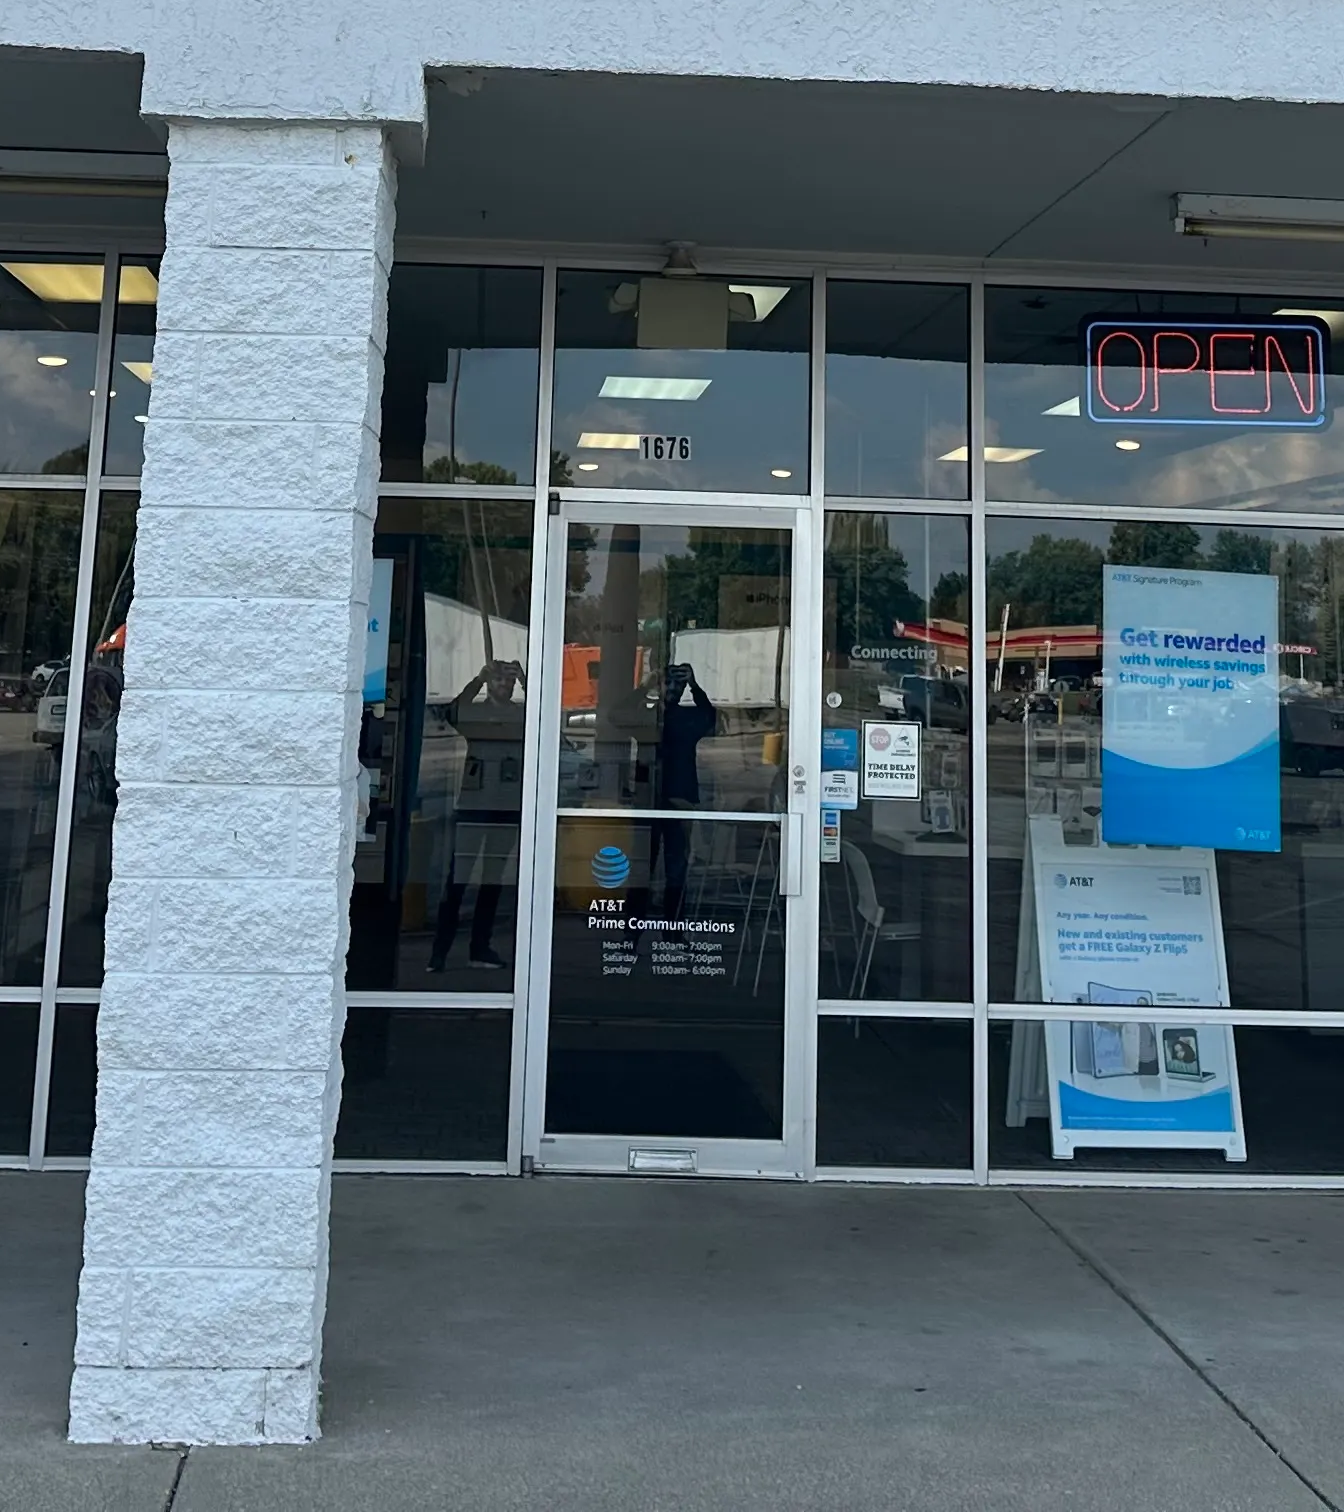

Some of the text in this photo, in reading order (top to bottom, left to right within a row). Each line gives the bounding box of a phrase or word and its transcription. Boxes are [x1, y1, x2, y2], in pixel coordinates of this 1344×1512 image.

[1097, 331, 1314, 414] OPEN
[642, 436, 689, 460] 1676
[1133, 575, 1168, 585] Signature
[1170, 576, 1202, 587] Program
[1120, 627, 1159, 648] Get
[1163, 632, 1266, 654] rewarded
[851, 645, 938, 664] Connecting
[1119, 653, 1266, 676] with wireless savings
[1119, 671, 1234, 692] through your job
[871, 735, 890, 744] STOP
[868, 763, 916, 772] TIME DELAY
[868, 771, 916, 780] PROTECTED
[1247, 829, 1271, 840] AT&T
[1069, 877, 1095, 887] AT&T
[589, 899, 625, 912] AT&T
[1057, 911, 1072, 921] Any
[1094, 912, 1108, 921] Any
[588, 916, 735, 933] Prime Communications
[1057, 928, 1203, 943] New and existing customers
[602, 941, 634, 950] Mon-Fri
[1058, 942, 1188, 956] get a FREE Galaxy Z Flip5
[602, 953, 638, 964] Saturday
[602, 965, 632, 976] Sunday
